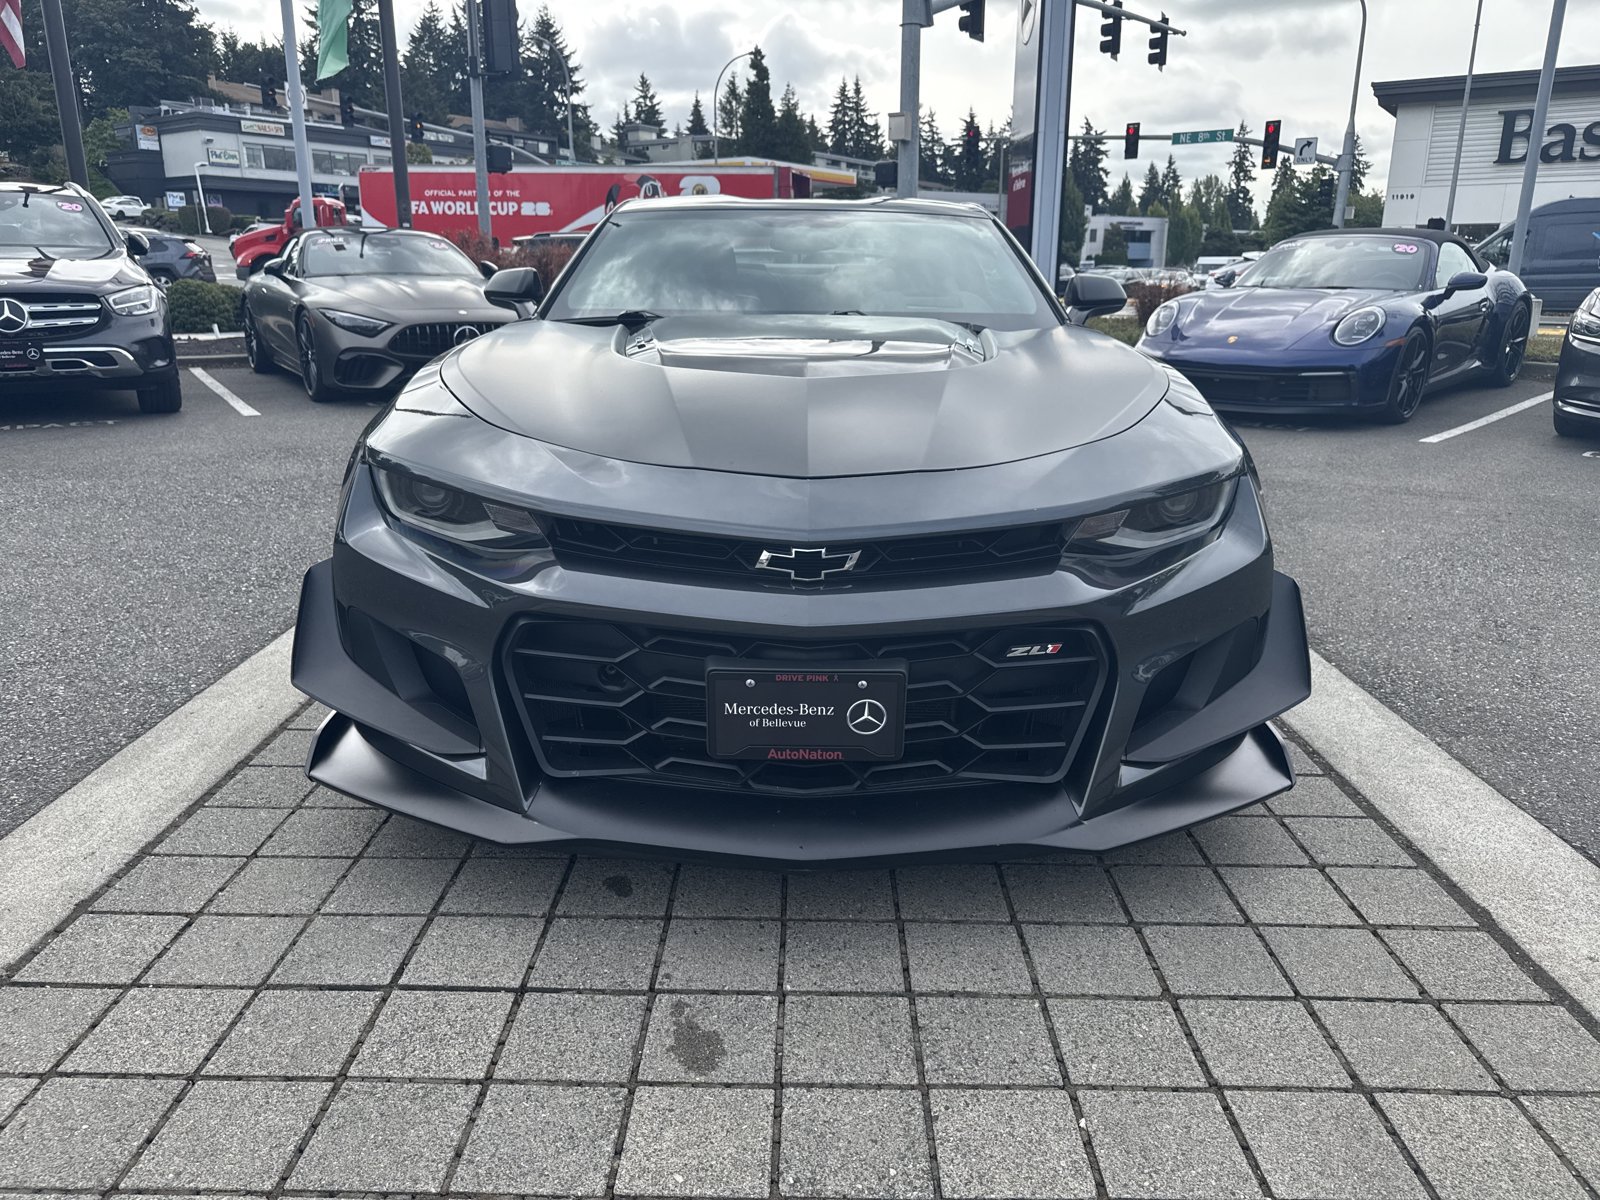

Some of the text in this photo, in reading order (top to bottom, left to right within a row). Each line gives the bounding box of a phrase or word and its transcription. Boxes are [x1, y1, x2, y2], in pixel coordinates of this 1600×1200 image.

[1179, 130, 1226, 144] NE 8th St
[424, 189, 456, 197] OFFICIAL
[411, 201, 429, 215] FA
[430, 201, 480, 215] WORL
[488, 201, 519, 216] CUP
[1006, 643, 1063, 658] ZL1
[775, 674, 829, 682] DRIVE PINK
[723, 702, 835, 717] Mercedes-Benz
[749, 718, 807, 728] of Bellevue
[767, 748, 843, 761] AutoNation
